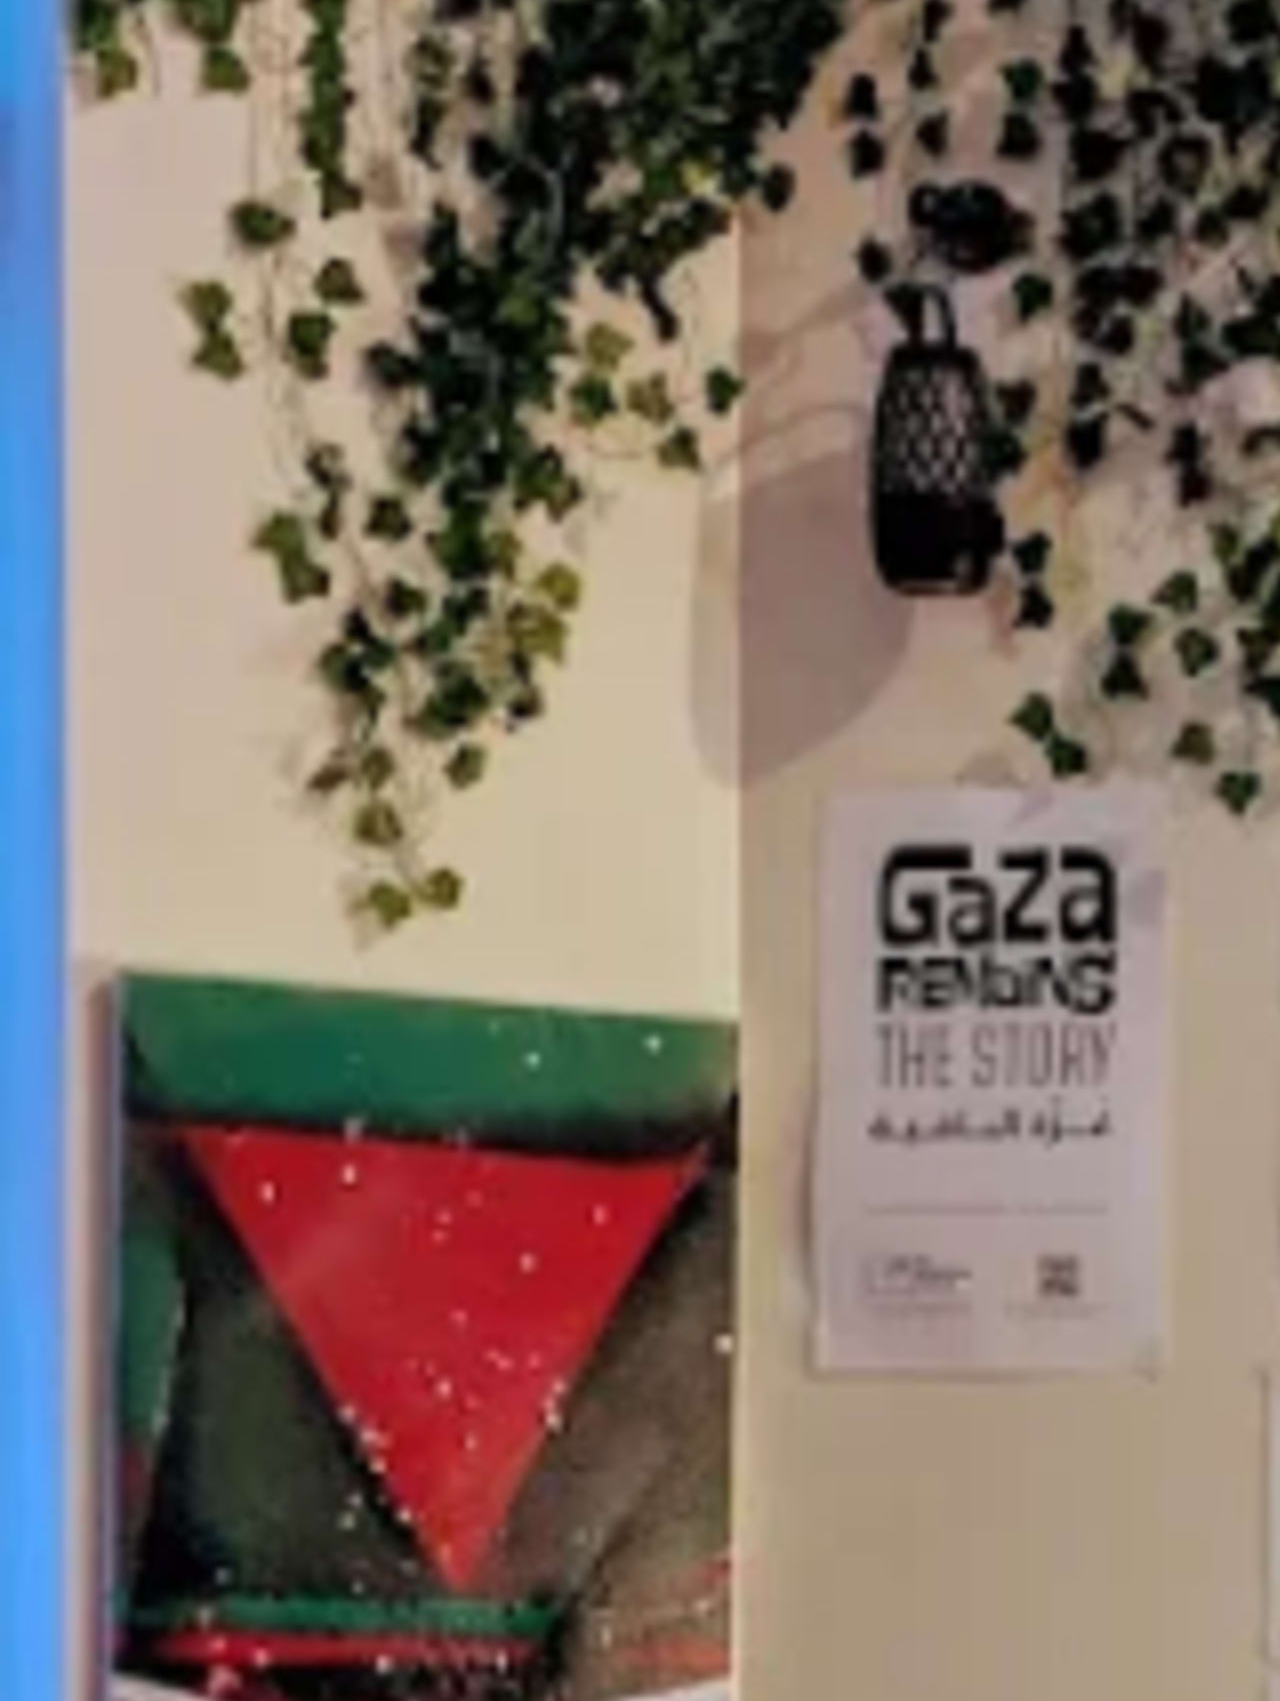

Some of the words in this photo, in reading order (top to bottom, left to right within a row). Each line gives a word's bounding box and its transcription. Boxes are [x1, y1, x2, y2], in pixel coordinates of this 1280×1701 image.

[876, 844, 1119, 949] Gaza
[876, 1020, 955, 1089] THE
[969, 1020, 1118, 1089] STORY
